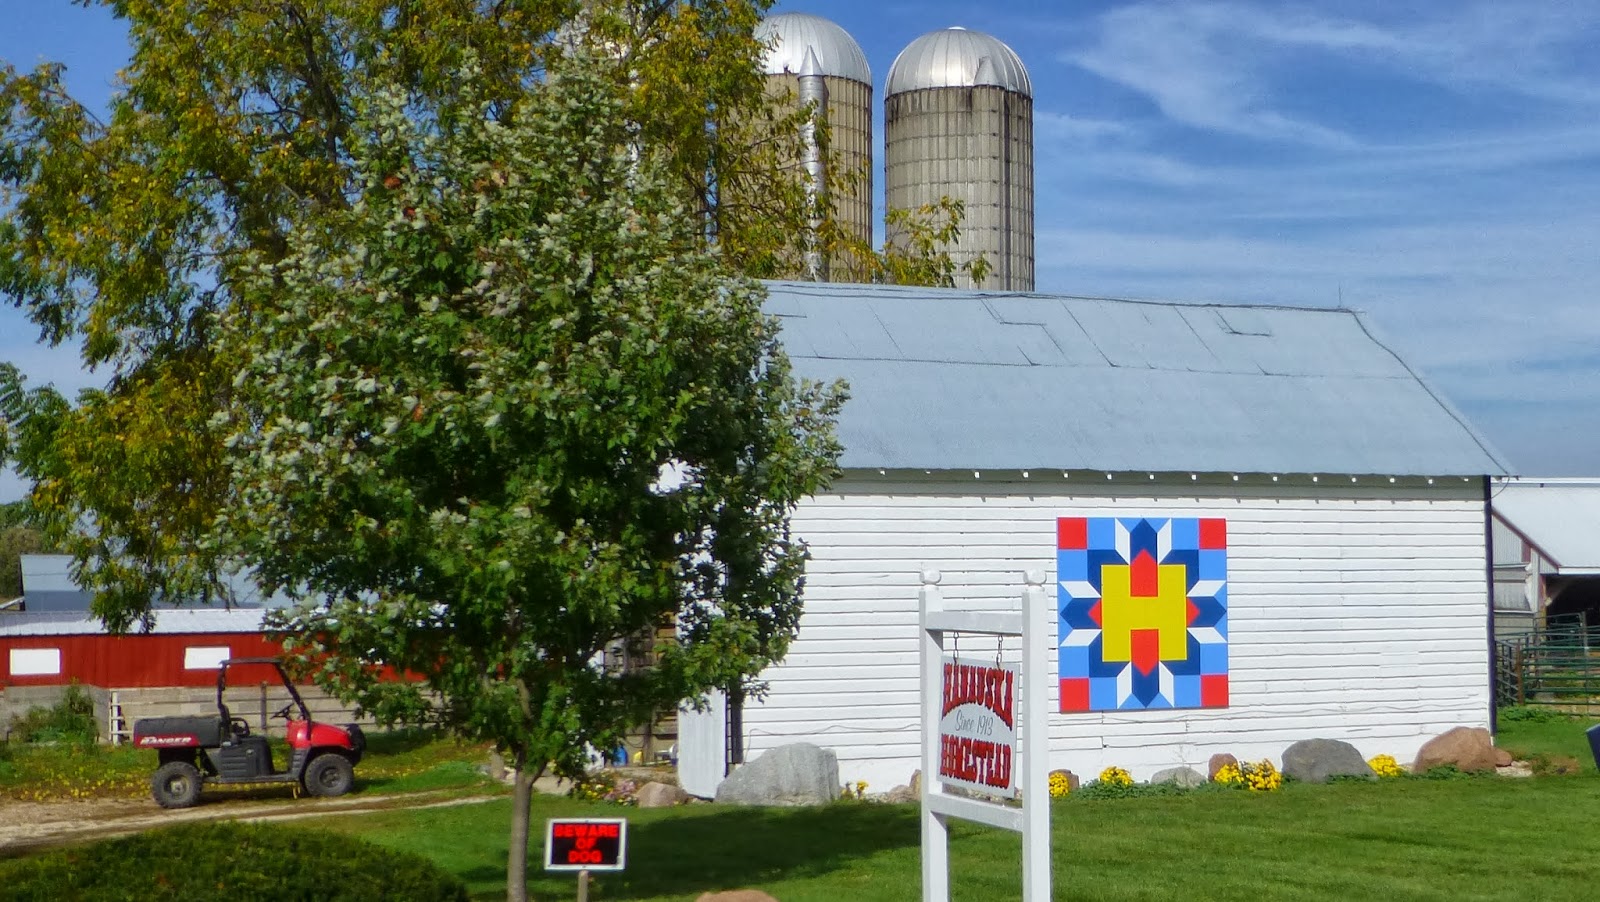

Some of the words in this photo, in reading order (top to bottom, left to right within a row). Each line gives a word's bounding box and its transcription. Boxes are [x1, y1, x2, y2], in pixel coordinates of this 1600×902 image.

[955, 709, 974, 732] Since
[977, 715, 994, 736] 1913
[940, 733, 1012, 790] HOMESTEAD
[554, 823, 619, 838] BEWARE
[576, 836, 598, 849] OF
[568, 849, 603, 864] DOG
